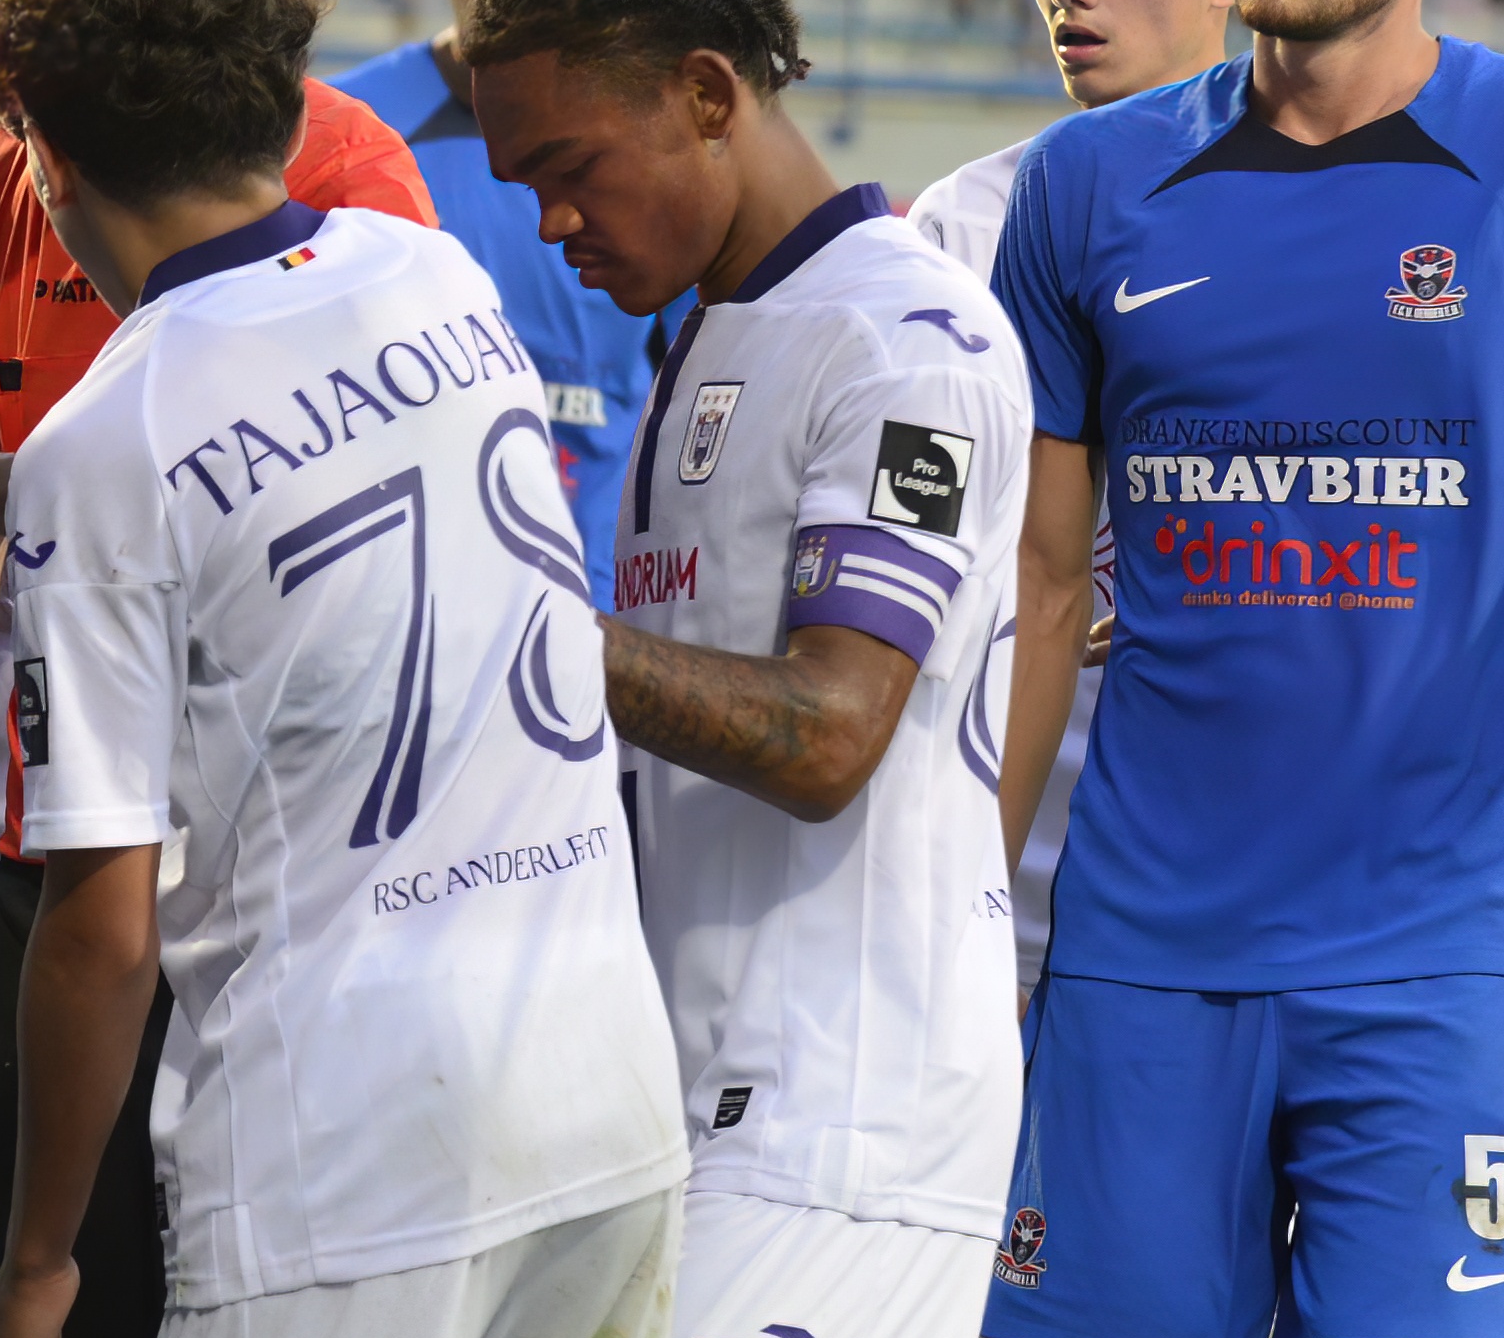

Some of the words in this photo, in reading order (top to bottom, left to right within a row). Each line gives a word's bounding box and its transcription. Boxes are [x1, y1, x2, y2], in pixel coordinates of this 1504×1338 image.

[1122, 417, 1476, 448] DRANKENDISCOUNT
[894, 471, 951, 497] League
[913, 458, 941, 476] Pro
[1125, 454, 1470, 506] STRAVBIER
[1181, 520, 1418, 589] drinxit
[1182, 591, 1232, 607] drinks
[1238, 590, 1333, 608] delivered
[1339, 592, 1415, 610] @home
[268, 407, 605, 849] 78
[374, 872, 438, 915] RSC
